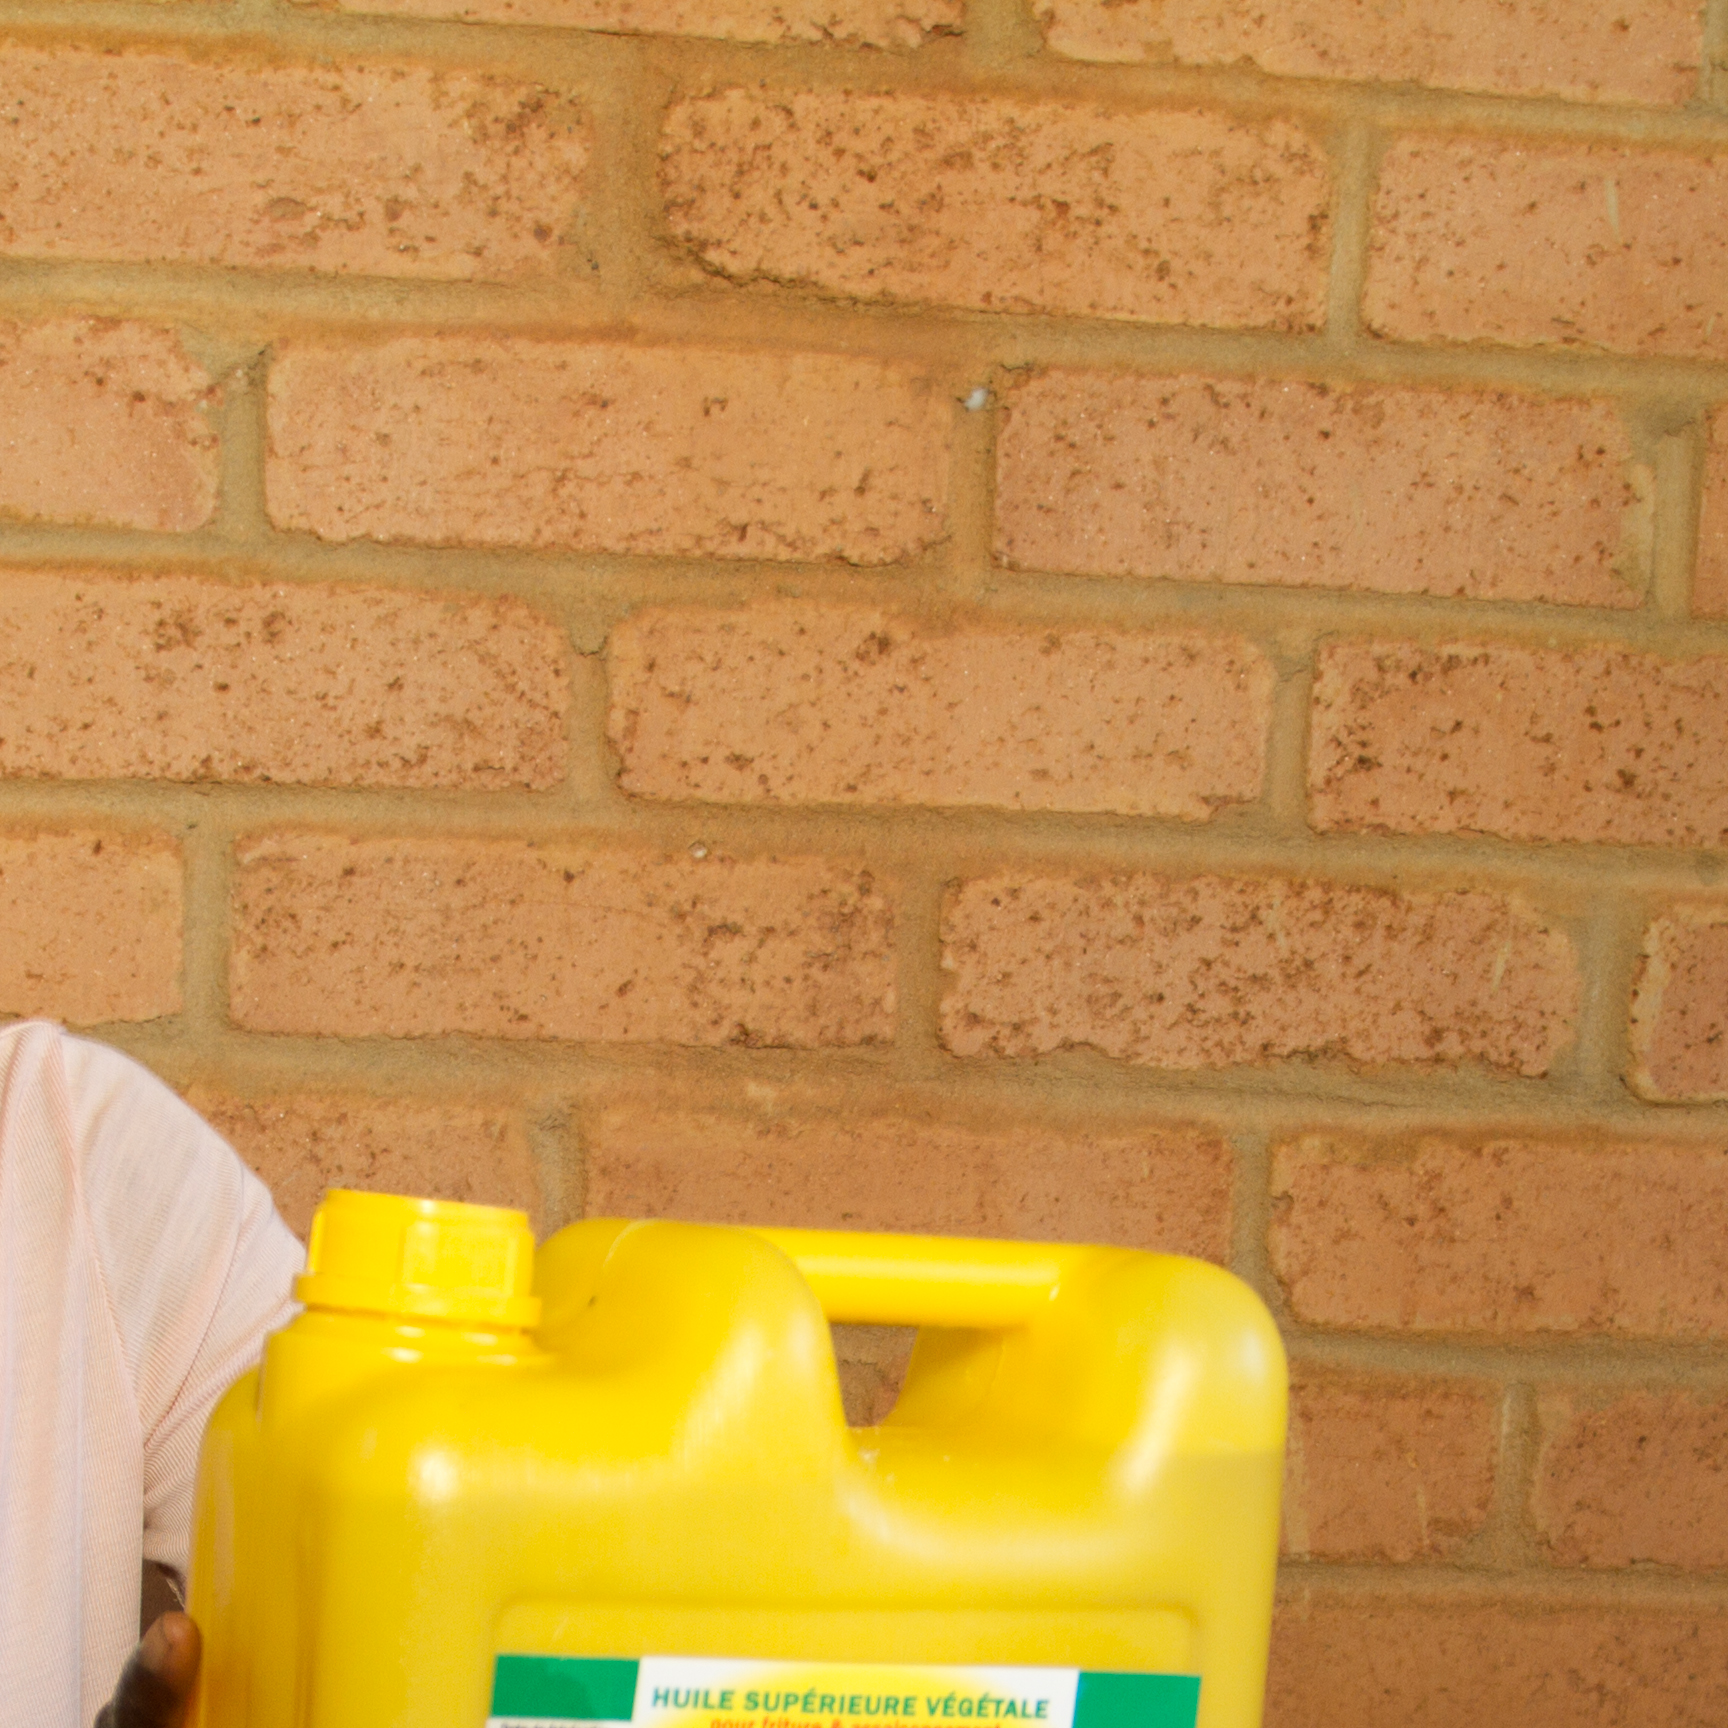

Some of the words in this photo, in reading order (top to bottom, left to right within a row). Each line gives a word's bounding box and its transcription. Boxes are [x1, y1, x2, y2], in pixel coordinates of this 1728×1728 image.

[652, 1686, 735, 1711] HUILE
[743, 1686, 917, 1716] SUPÉRIEURE
[927, 1691, 1050, 1720] VÉGÉTALE
